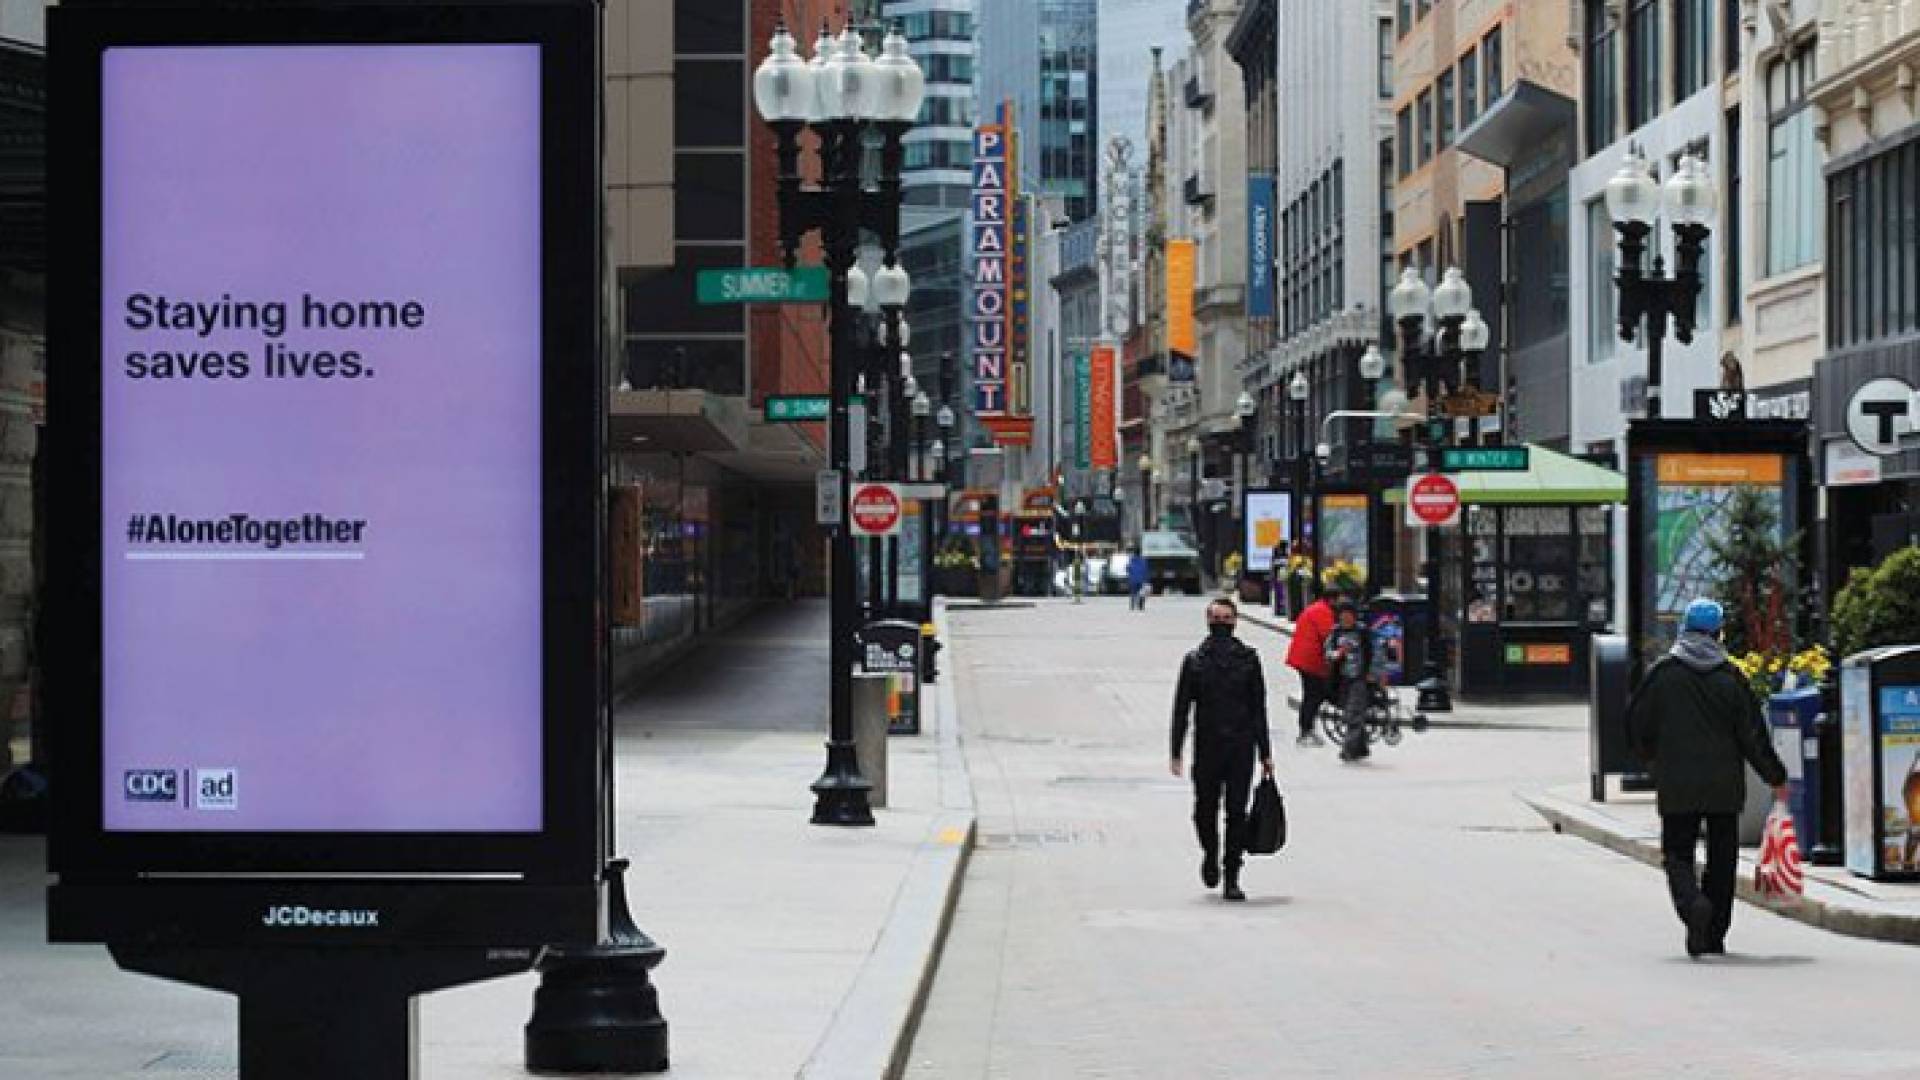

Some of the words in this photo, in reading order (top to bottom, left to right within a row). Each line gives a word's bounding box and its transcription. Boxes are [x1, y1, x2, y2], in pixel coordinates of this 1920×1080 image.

[720, 272, 790, 299] SUMMER
[978, 132, 1003, 409] PARAMOUNT
[125, 292, 287, 338] Staying
[302, 293, 425, 330] home
[125, 350, 250, 379] saves
[263, 342, 375, 379] lives.
[1860, 401, 1909, 444] T
[126, 512, 368, 550] #AloneTogether
[128, 774, 176, 795] CDC
[201, 771, 233, 797] ad
[262, 905, 379, 926] JCDecaux
